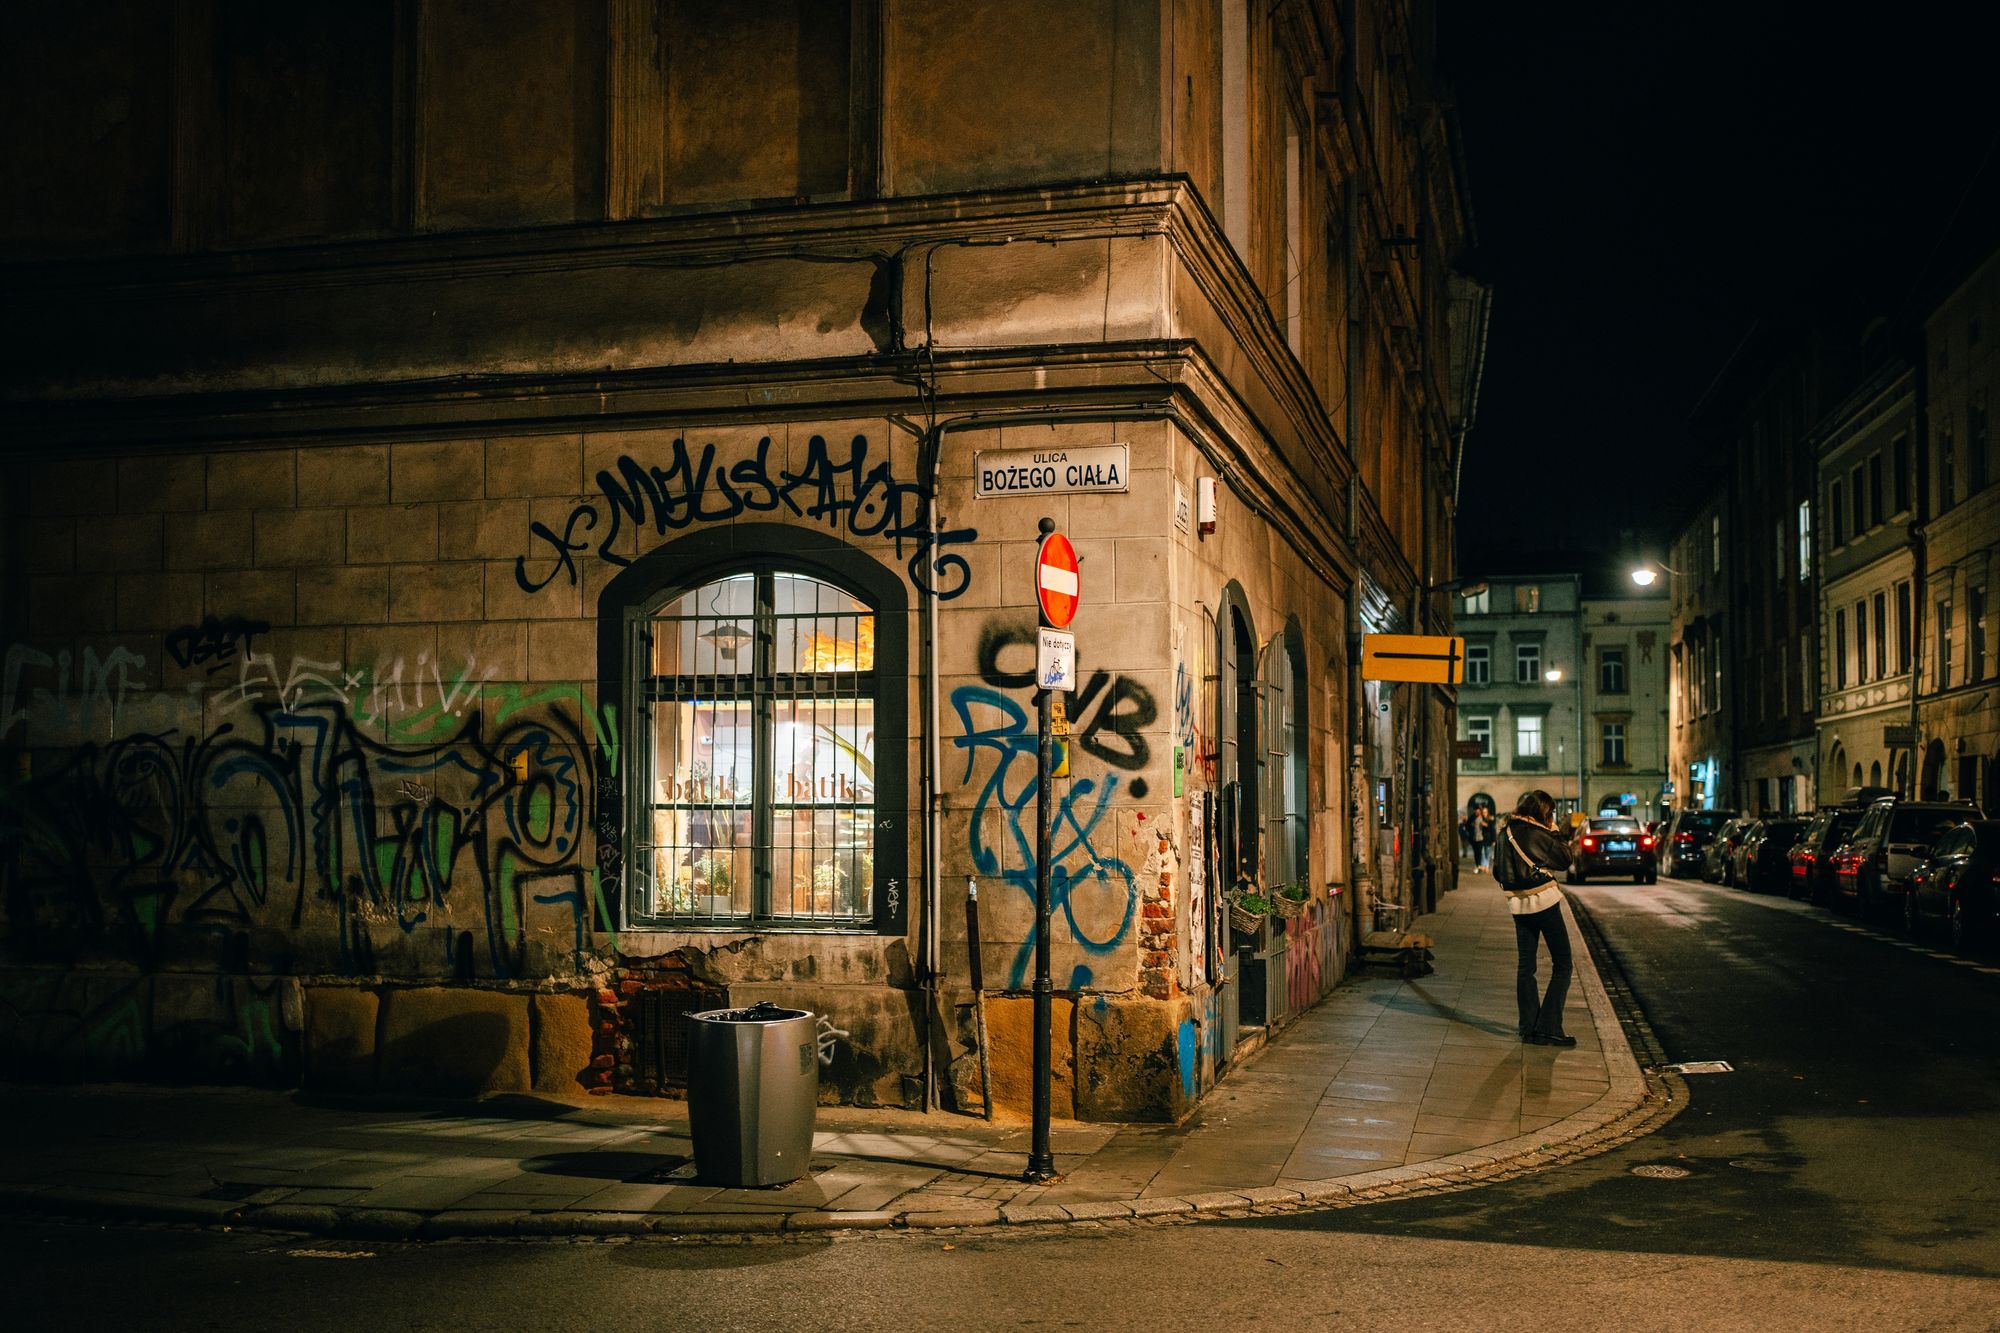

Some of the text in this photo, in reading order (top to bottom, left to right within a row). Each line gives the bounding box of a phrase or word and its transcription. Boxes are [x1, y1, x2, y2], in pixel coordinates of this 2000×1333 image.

[1033, 452, 1068, 464] ULICA
[983, 463, 1120, 491] BOŻEGO CIAŁA
[1042, 636, 1073, 653] Nie dotyczy
[787, 772, 857, 799] batik
